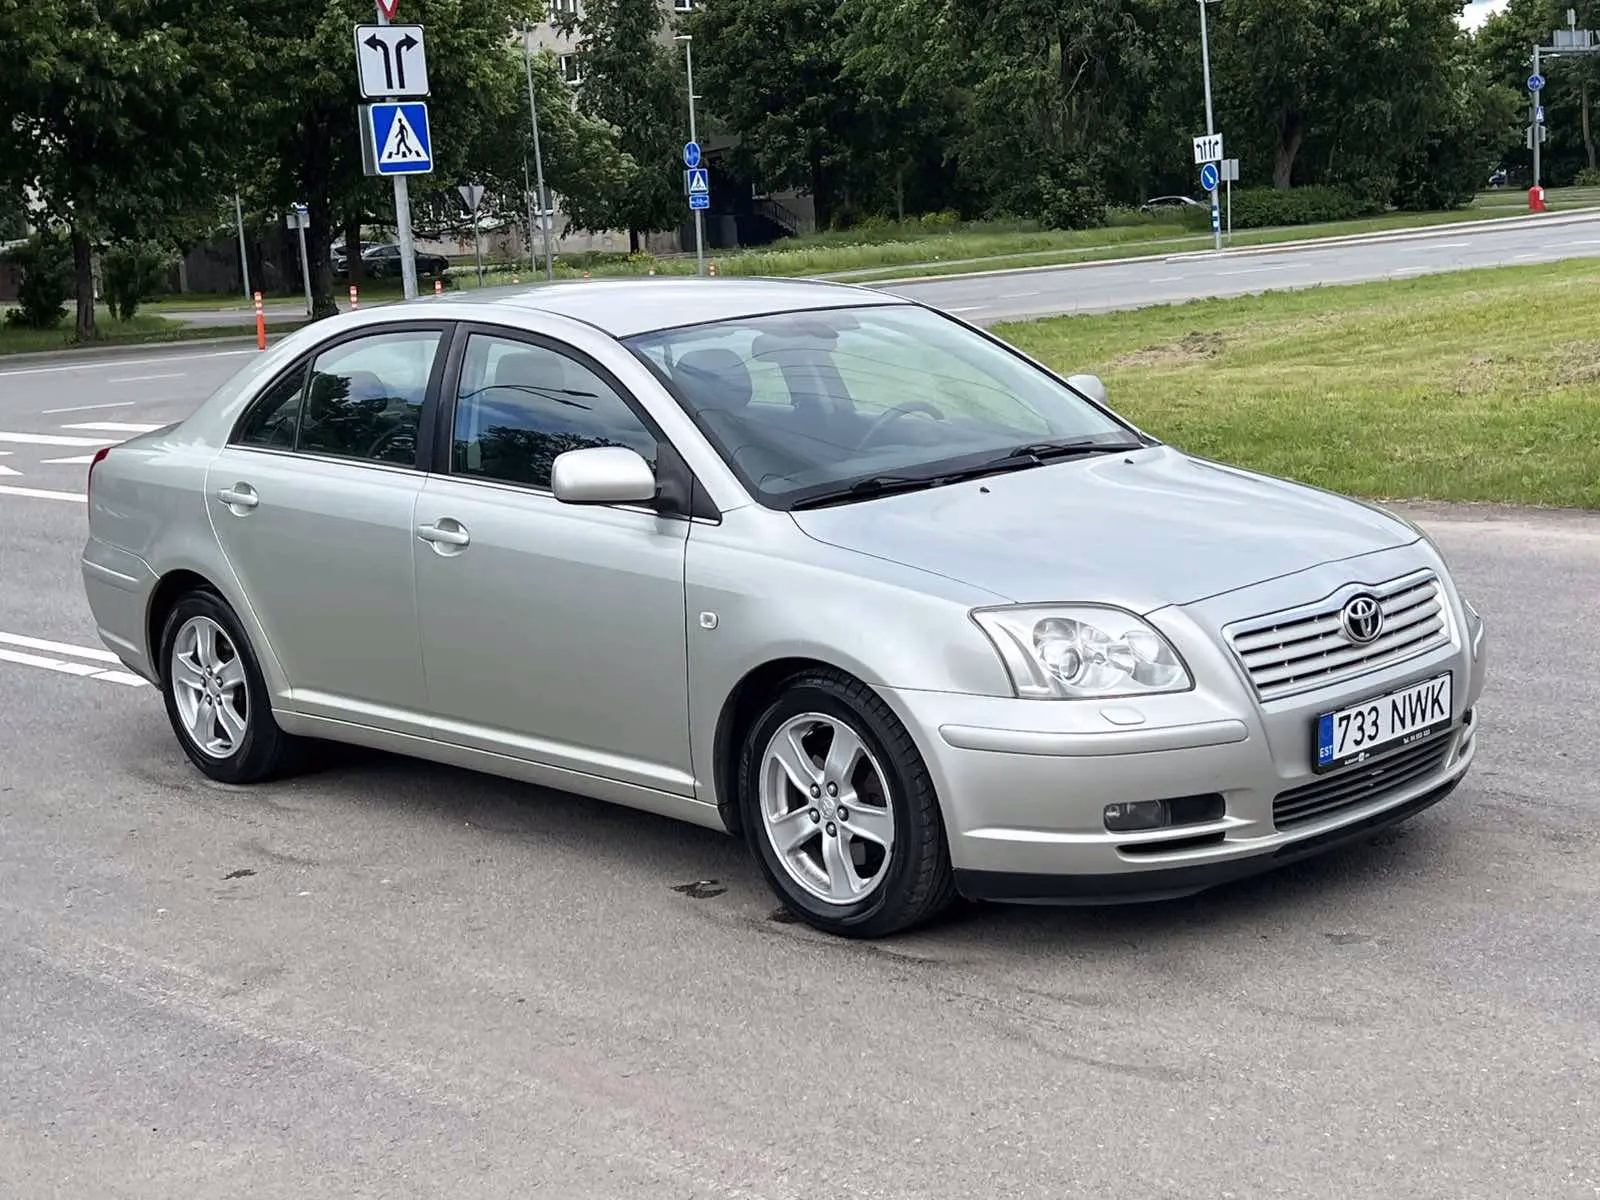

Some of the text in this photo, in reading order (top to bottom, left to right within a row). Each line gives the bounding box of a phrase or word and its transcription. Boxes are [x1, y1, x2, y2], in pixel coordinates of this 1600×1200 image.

[1338, 680, 1446, 753] 733 NWK
[1319, 745, 1333, 758] EST
